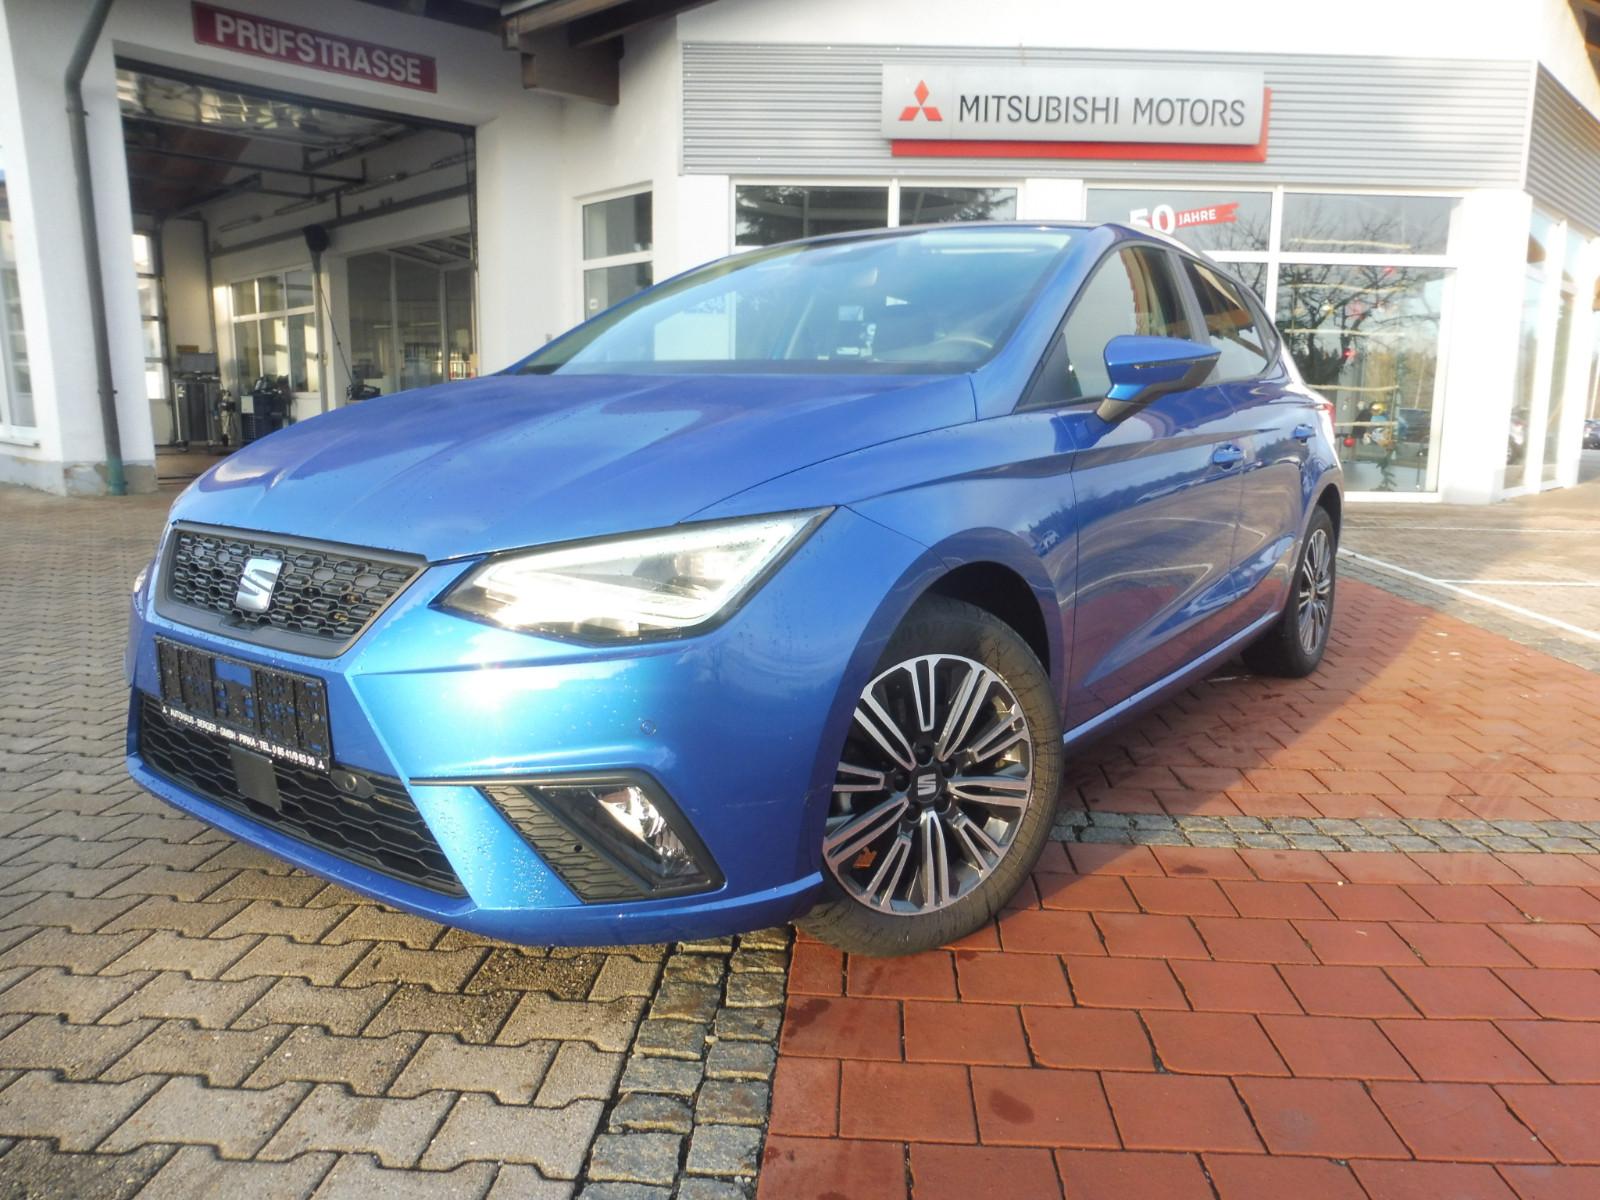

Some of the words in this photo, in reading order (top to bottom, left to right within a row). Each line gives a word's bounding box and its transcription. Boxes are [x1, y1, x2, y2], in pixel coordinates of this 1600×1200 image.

[214, 13, 422, 85] PRÜFSTRASSE
[959, 94, 1119, 124] MITSUBISHI
[1133, 97, 1246, 127] MOTORS
[1178, 208, 1217, 225] JAHRE
